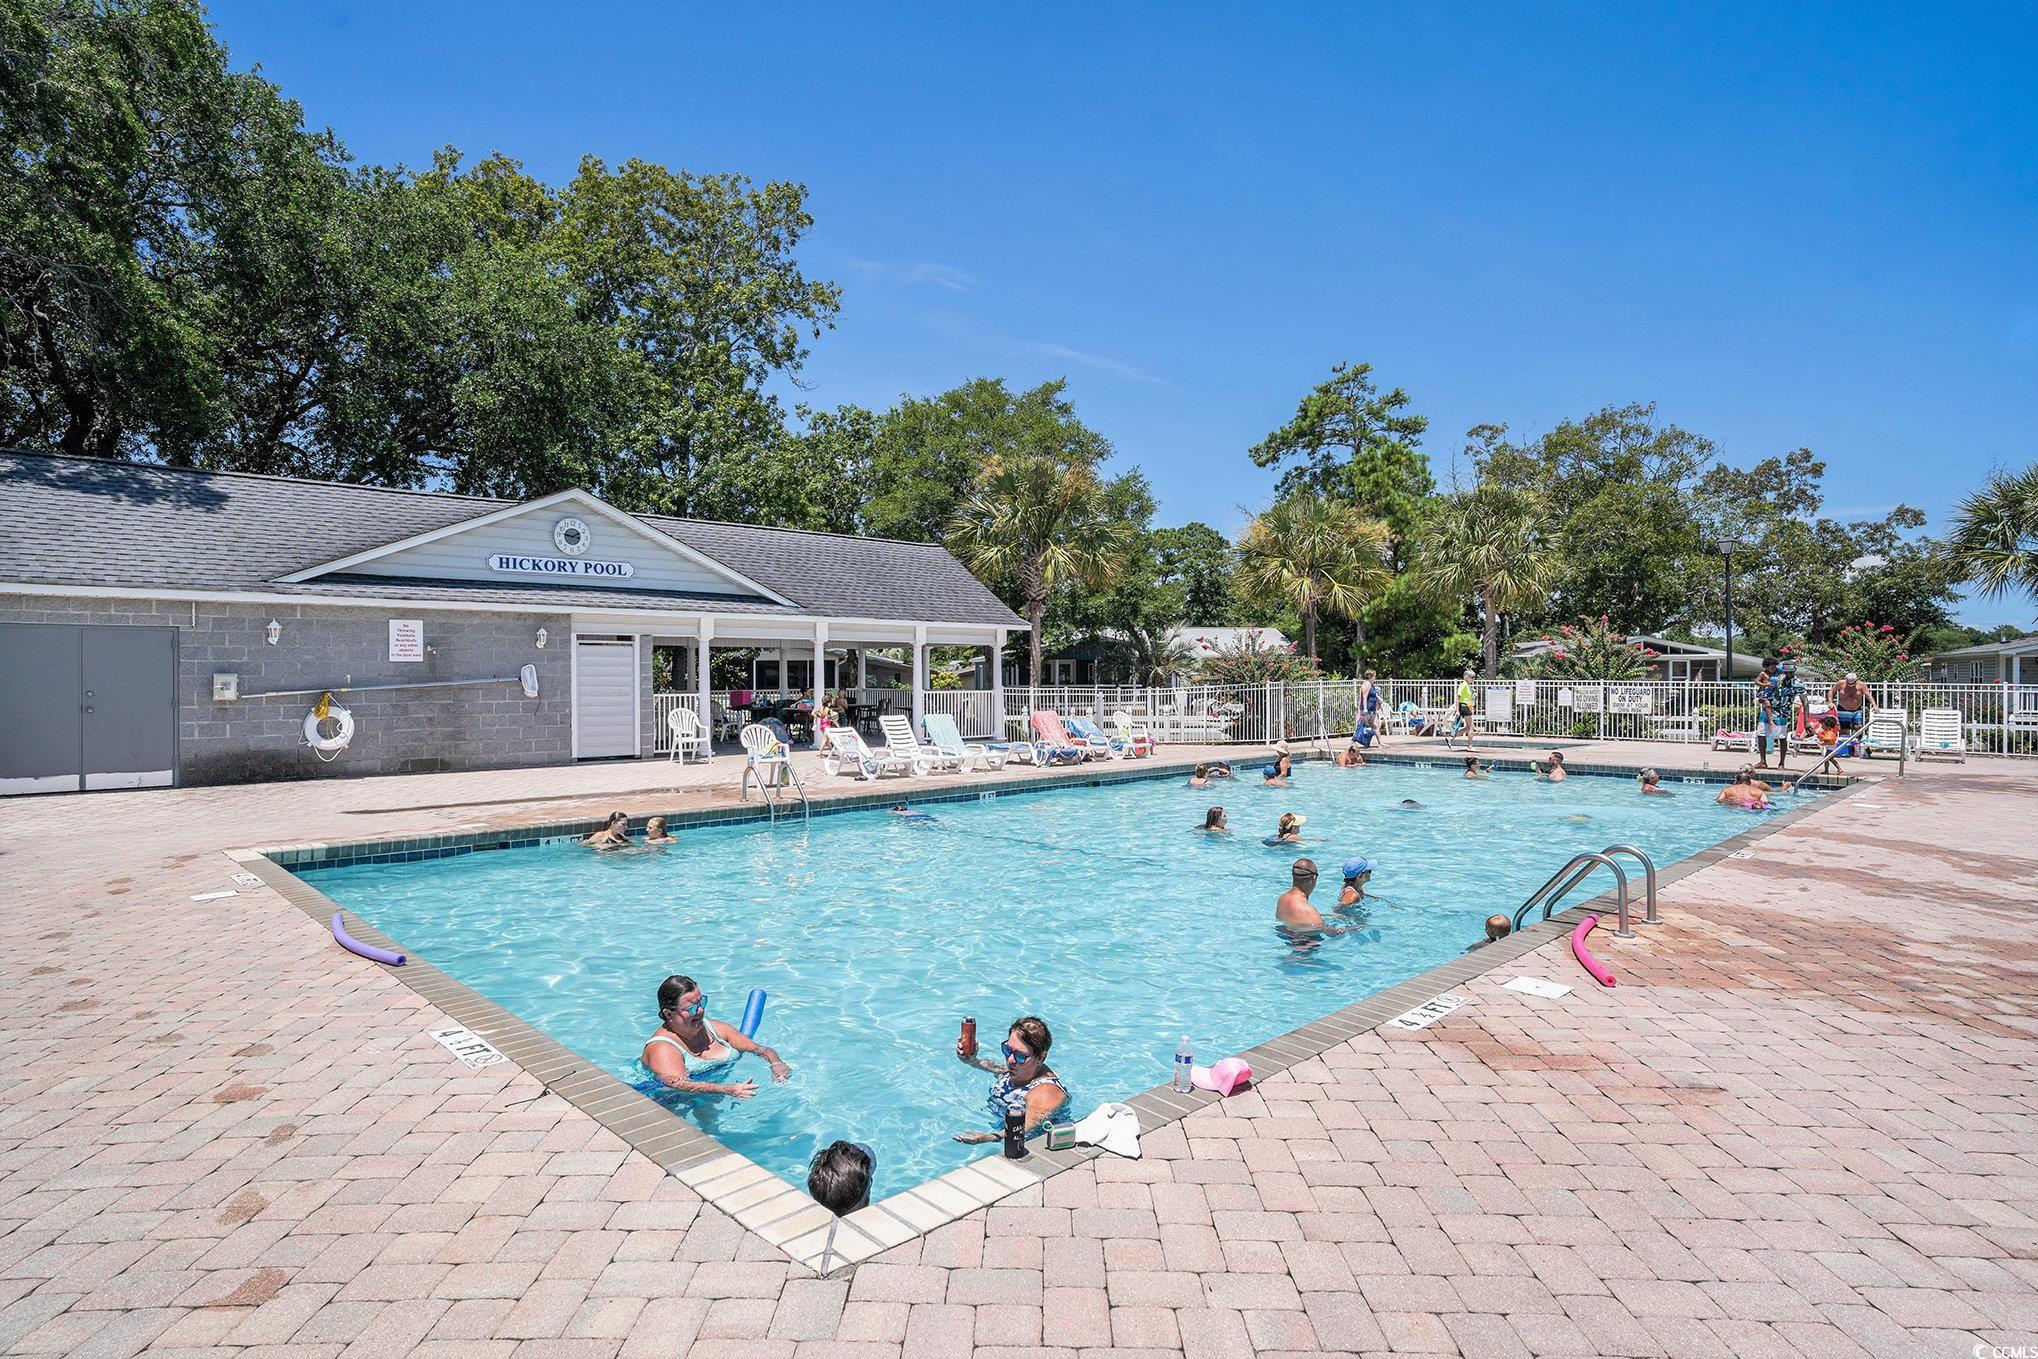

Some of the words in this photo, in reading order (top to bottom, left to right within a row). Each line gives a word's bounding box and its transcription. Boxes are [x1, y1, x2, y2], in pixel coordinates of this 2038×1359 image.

[498, 556, 579, 573] HICKORY
[584, 562, 627, 576] POOL
[1421, 1002, 1451, 1013] FT
[456, 1044, 492, 1056] FT
